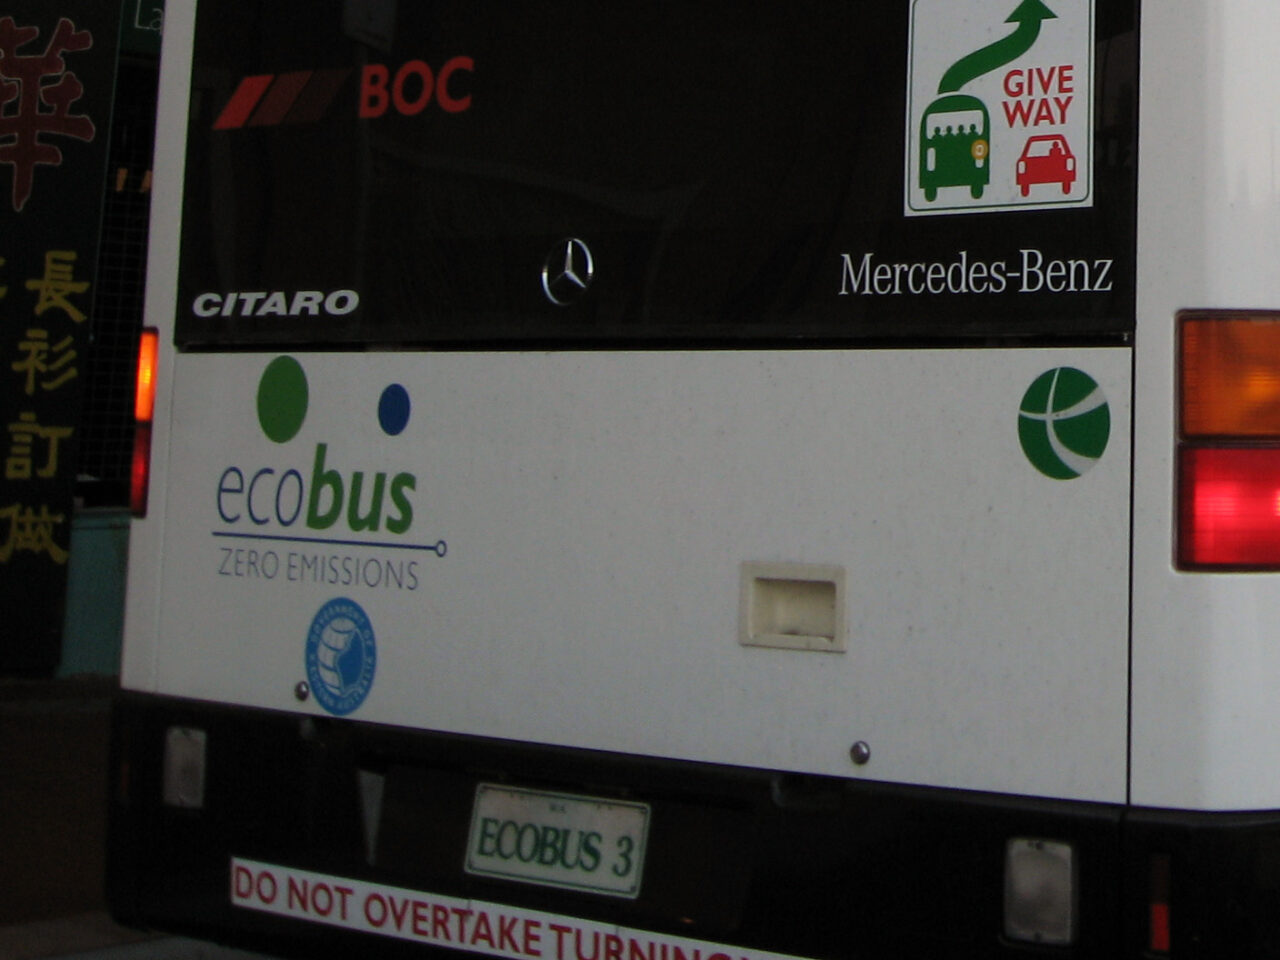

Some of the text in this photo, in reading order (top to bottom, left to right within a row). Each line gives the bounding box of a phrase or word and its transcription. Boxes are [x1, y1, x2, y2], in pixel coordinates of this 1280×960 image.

[358, 56, 475, 119] BOC
[1003, 64, 1075, 97] GIVE
[1001, 96, 1074, 129] WAY
[838, 249, 1115, 296] Mercedes-Benz
[192, 289, 360, 318] CITARO
[217, 443, 417, 535] ecobus
[217, 547, 420, 590] ZERO EMISSIONS
[477, 817, 636, 879] ECOBUS 3
[234, 865, 277, 905] DO
[287, 876, 354, 920] NOT
[363, 890, 543, 956] OVERTAKE
